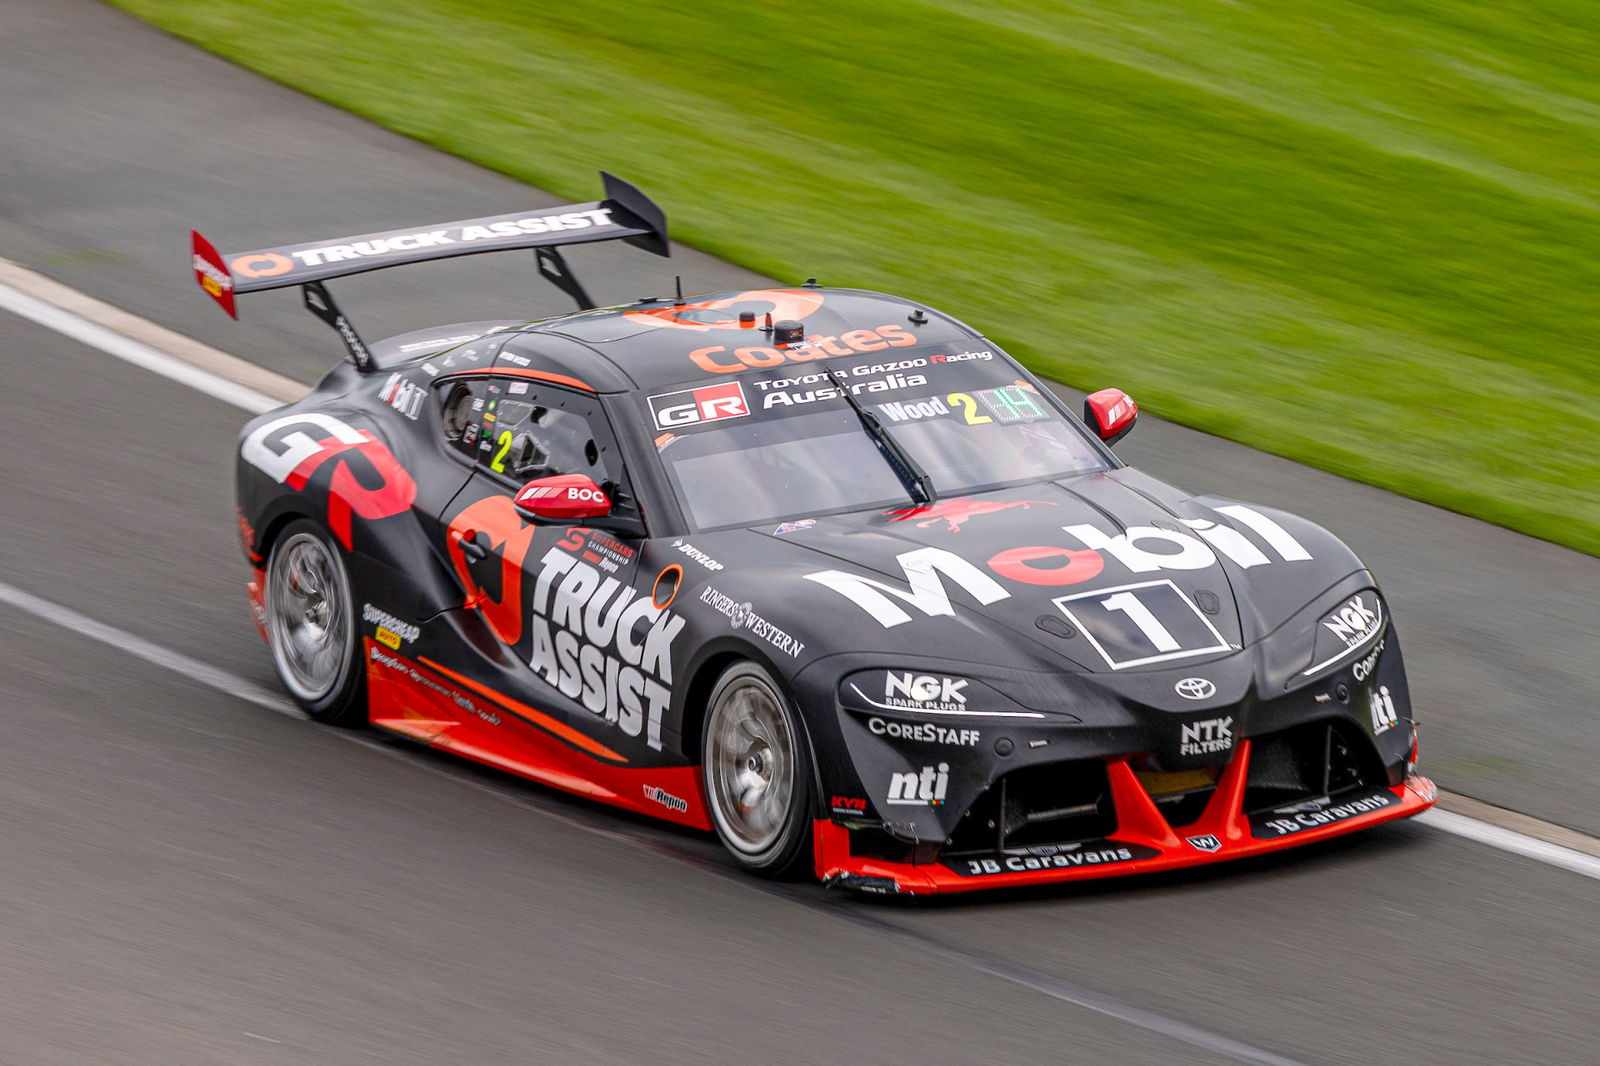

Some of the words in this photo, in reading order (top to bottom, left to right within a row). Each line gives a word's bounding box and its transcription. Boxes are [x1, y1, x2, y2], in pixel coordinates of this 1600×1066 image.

[294, 229, 456, 267] TRUCK
[461, 207, 614, 242] ASSIST
[689, 324, 918, 375] Coates
[851, 357, 928, 377] GAZOO
[930, 350, 994, 366] Racing
[656, 386, 750, 428] GR
[878, 396, 950, 423] Wood
[947, 392, 994, 426] 2
[489, 430, 513, 474] 2
[567, 487, 605, 504] BOC
[678, 543, 725, 573] DUNLOP
[802, 504, 1314, 630] Mobil
[532, 546, 687, 687] TRUCK
[699, 585, 737, 619] RINGERS
[744, 613, 806, 660] WESTERN
[1099, 592, 1182, 654] 1
[1322, 594, 1376, 642] NGK
[529, 613, 672, 752] ASSIST
[884, 669, 969, 702] NGK
[885, 696, 923, 710] SPARK
[924, 699, 966, 712] PLUGS
[1180, 715, 1234, 744] NTK
[1180, 736, 1233, 757] FILTERS
[887, 762, 951, 800] nti
[1264, 818, 1302, 837] JB
[1303, 793, 1391, 828] Caravans
[967, 858, 1001, 877] JB
[1005, 846, 1133, 873] Caravans
